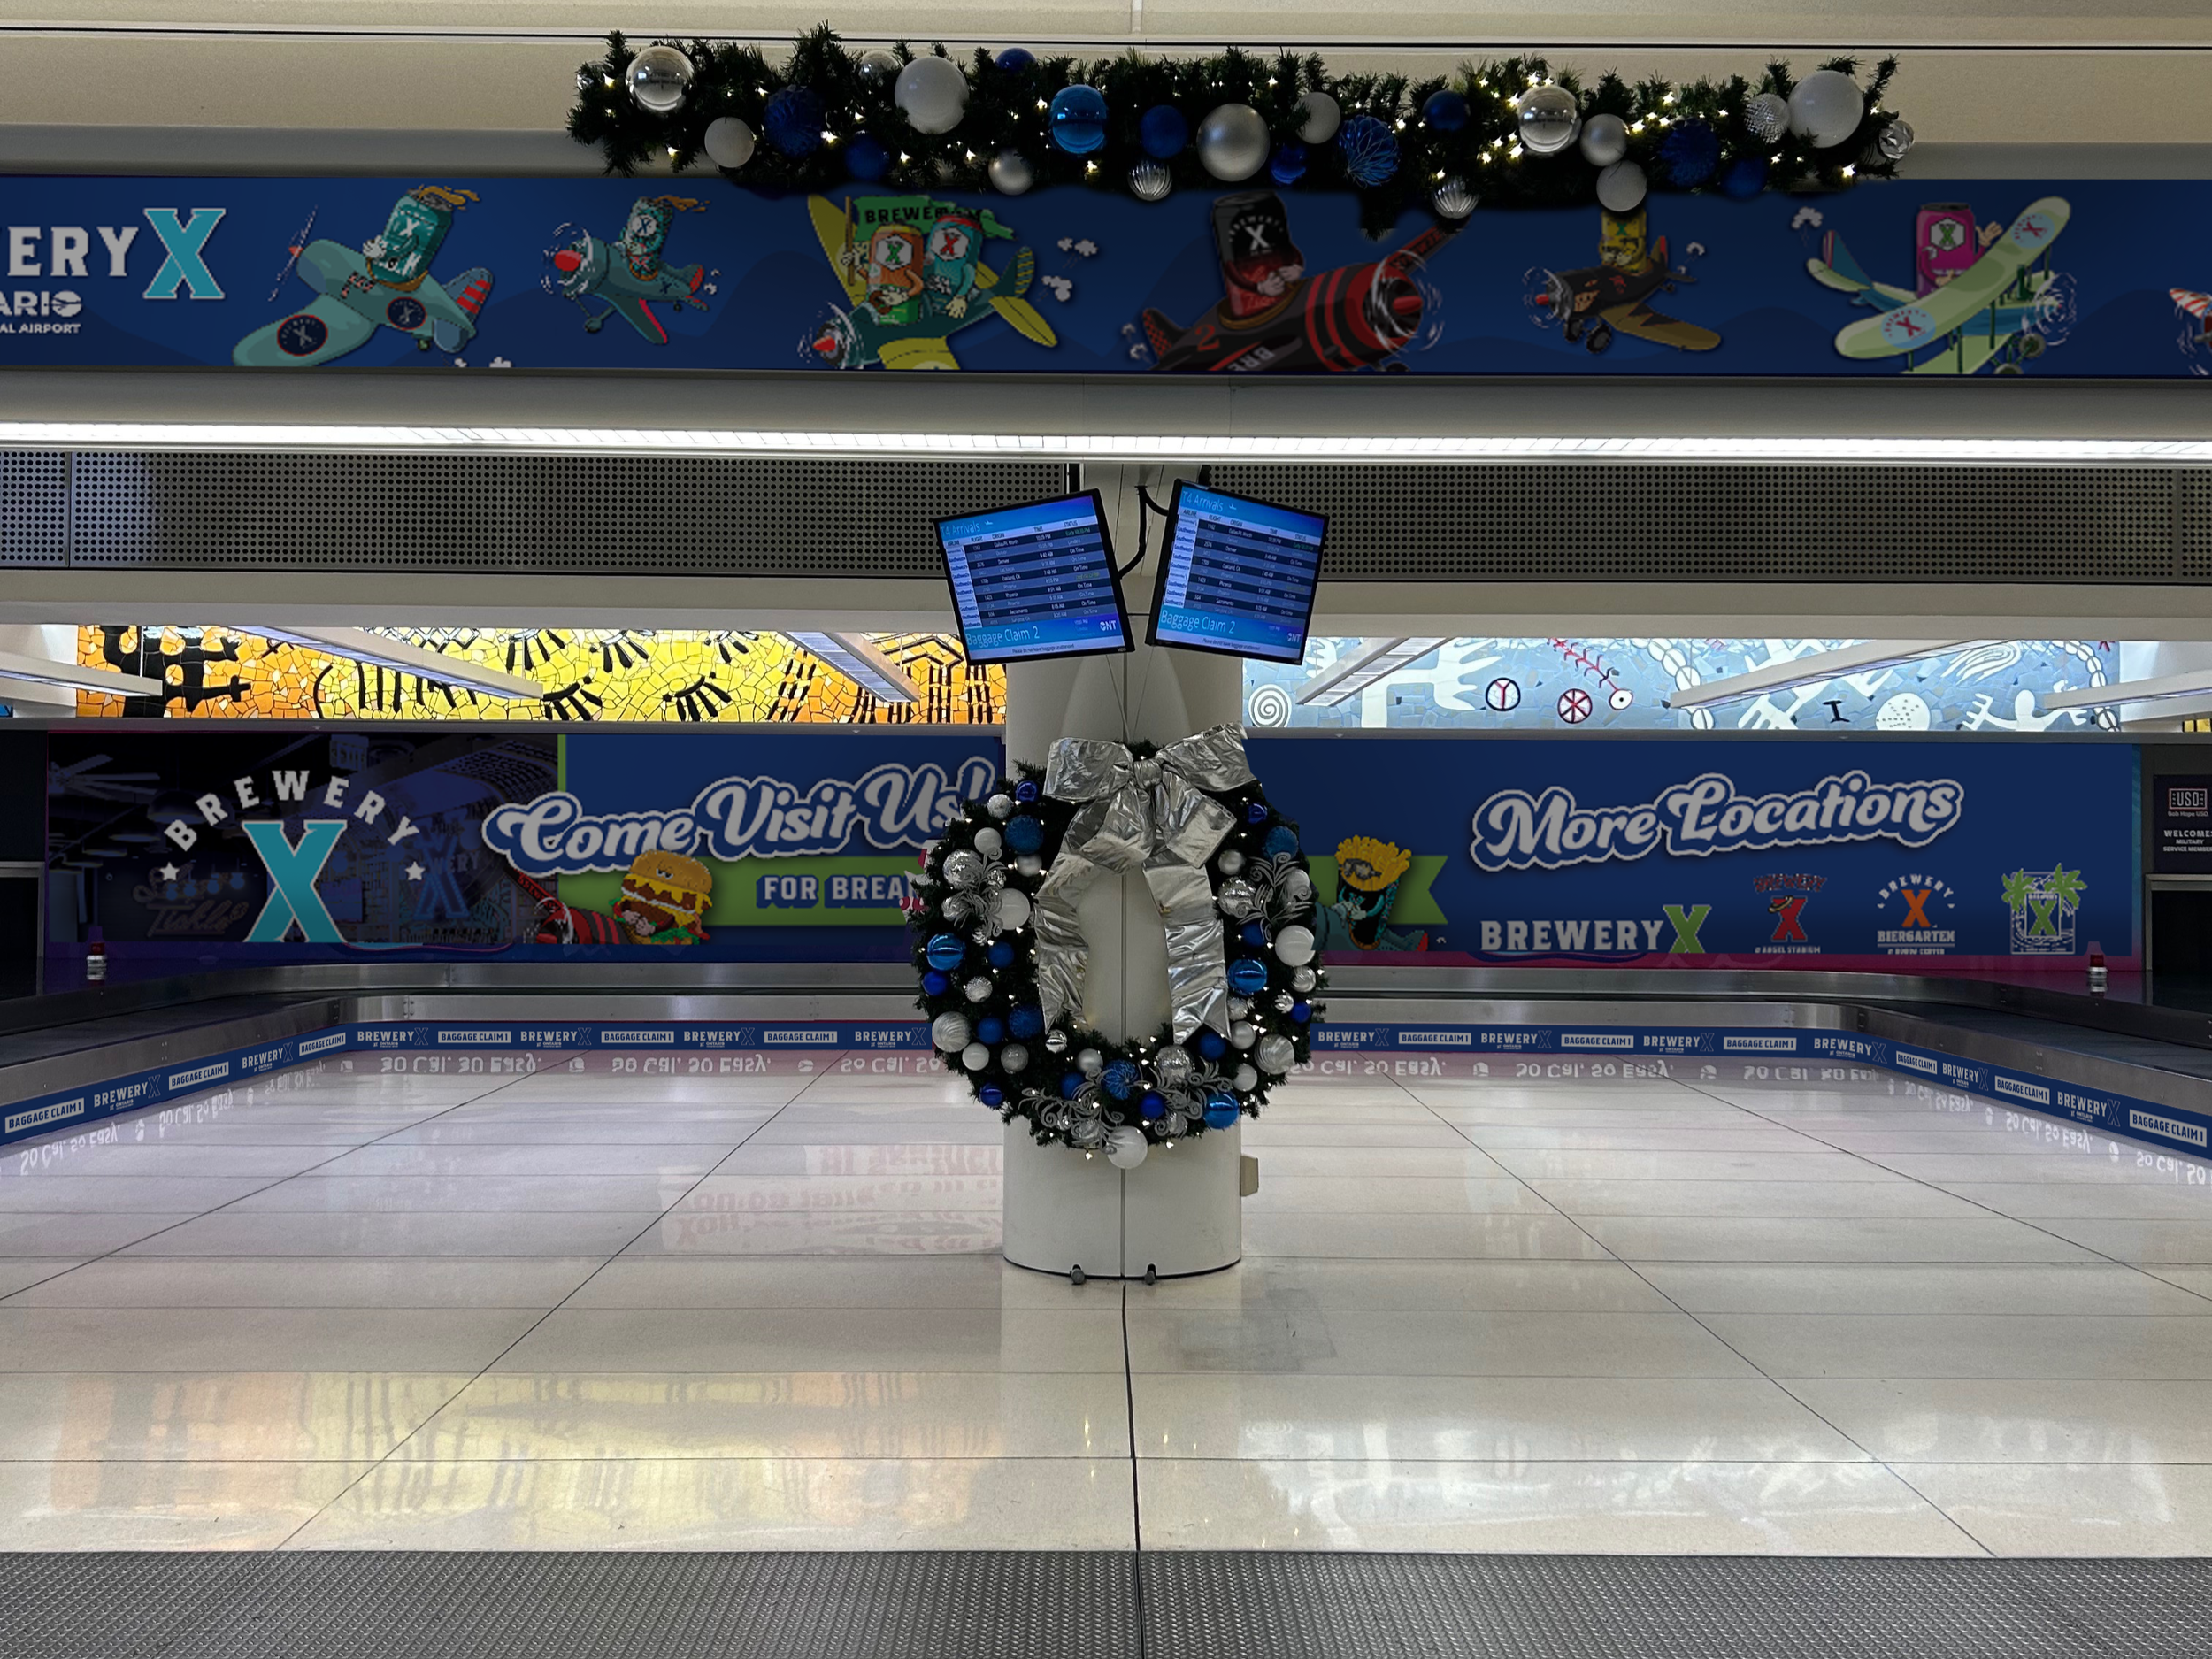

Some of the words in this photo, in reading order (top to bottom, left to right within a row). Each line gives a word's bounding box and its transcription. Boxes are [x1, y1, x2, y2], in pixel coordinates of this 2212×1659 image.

[142, 207, 227, 299] X
[19, 323, 81, 334] AIRPORT
[1195, 324, 1220, 352] 2
[1193, 493, 1224, 511] Arrivals
[950, 520, 981, 536] Arrivals
[1159, 609, 1200, 632] Baggage
[1200, 615, 1226, 633] Claim
[1228, 620, 1236, 634] 2
[964, 629, 1003, 649] Baggage
[1002, 626, 1031, 641] Claim
[1031, 626, 1040, 639] 2
[2177, 791, 2200, 807] USO
[164, 769, 420, 852] BREWERY
[1486, 795, 1658, 857] More
[1667, 776, 1955, 841] Locations
[494, 795, 692, 861] Come
[702, 780, 857, 844] Visit
[241, 819, 348, 943] X
[764, 876, 817, 901] FOR
[833, 876, 911, 901] BREA
[1901, 889, 1932, 928] X
[2028, 899, 2058, 936] X
[1770, 895, 1809, 943] X
[1480, 920, 1663, 952] BREWERY
[1662, 903, 1712, 955] X
[1877, 930, 1955, 943] BIERGARTEN
[301, 1041, 323, 1054] BAGGAGE
[323, 1037, 342, 1048] CLAIM
[357, 1031, 414, 1041] BREWERY
[441, 1033, 478, 1041] BAGGAGE
[479, 1033, 503, 1041] CLAIM
[520, 1031, 577, 1041] BREWERY
[604, 1033, 641, 1041] BAGGAGE
[642, 1033, 666, 1041] CLAIM
[684, 1031, 741, 1041] BREWERY
[768, 1033, 804, 1041] BAGGAGE
[805, 1033, 830, 1041] CLAIM
[855, 1031, 911, 1041] BREWERY
[1318, 1031, 1375, 1041] BREWERY
[1402, 1033, 1438, 1042] BAGGAGE
[1481, 1033, 1538, 1044] BREWERY
[1564, 1036, 1601, 1045] BAGGAGE
[1602, 1037, 1626, 1046] CLAIM
[1643, 1035, 1700, 1048] BREWERY
[1727, 1040, 1763, 1048] BAGGAGE
[1764, 1040, 1788, 1048] CLAIM
[1814, 1038, 1872, 1056] BREWERY
[242, 1048, 283, 1069] BREWERY
[1898, 1053, 1918, 1067] BAGGAGE
[1918, 1057, 1932, 1071] CLAIM
[172, 1070, 203, 1087] BAGGAGE
[204, 1064, 224, 1079] CLAIM
[1942, 1063, 1978, 1083] BREWERY
[94, 1081, 149, 1108] BREWERY
[1997, 1079, 2024, 1094] BAGGAGE
[2024, 1086, 2043, 1099] CLAIM
[2057, 1091, 2107, 1117] BREWERY
[9, 1110, 50, 1129] BAGGAGE
[50, 1102, 77, 1118] CLAIM
[2132, 1114, 2170, 1133] BAGGAGE
[2171, 1124, 2198, 1141] CLAIM
